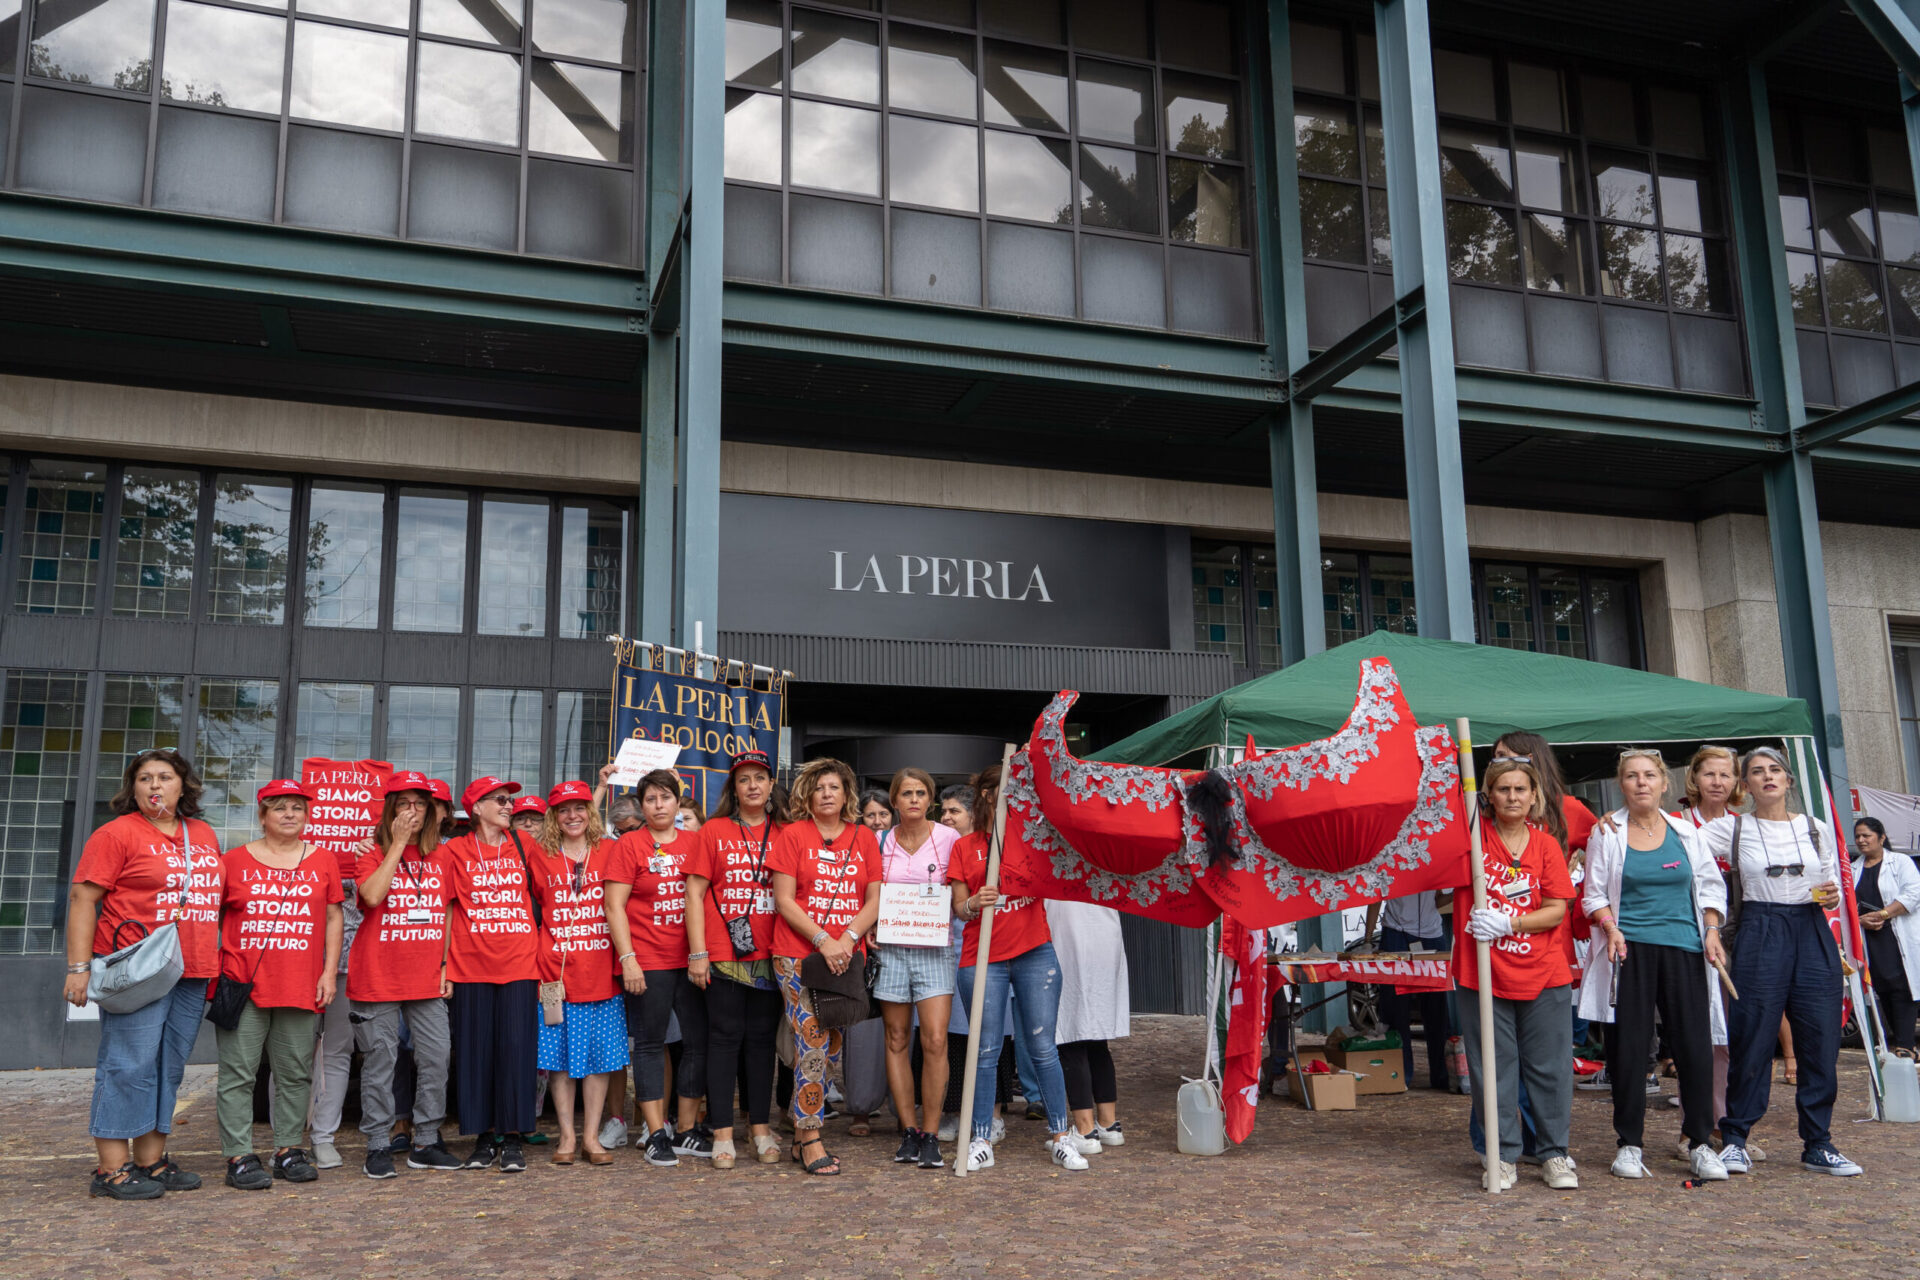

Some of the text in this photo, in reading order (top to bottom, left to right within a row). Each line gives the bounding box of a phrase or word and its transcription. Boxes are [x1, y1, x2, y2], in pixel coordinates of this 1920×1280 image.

[828, 551, 1054, 602] LA PERLA
[620, 675, 774, 732] LA PERLA
[309, 771, 382, 787] LA PERLA
[317, 788, 372, 803] SIAMO
[312, 806, 372, 820] STORIA
[303, 824, 376, 837] PRESENTE
[314, 840, 360, 852] FUTUR
[718, 840, 736, 851] LA
[727, 853, 766, 866] SIAM
[976, 850, 988, 862] L
[465, 860, 482, 872] LA
[660, 866, 680, 878] SIA
[242, 869, 319, 882] LA PERLA
[390, 876, 440, 889] SIAMO
[472, 872, 522, 886] SIAMO
[548, 871, 606, 888] LA PRL
[250, 883, 312, 896] SIAMO
[554, 886, 604, 903] SIAMO
[658, 881, 686, 896] STO
[1484, 873, 1531, 907] SIAO
[156, 891, 220, 906] PRSENT
[388, 894, 443, 908] STORIA
[470, 890, 524, 904] STORIA
[246, 900, 311, 916] STORIA
[654, 898, 686, 912] PRES
[720, 904, 778, 914] E FUT
[156, 909, 166, 922] E
[382, 912, 446, 926] PRETE
[468, 907, 528, 920] PRESENTE
[552, 904, 606, 922] STORIA
[817, 913, 856, 925] FTUR
[240, 920, 314, 935] PRESENTE
[480, 922, 532, 934] FUTURO
[654, 916, 662, 926] E
[380, 929, 442, 942] E FUTURO
[550, 922, 610, 938] PRESENTE
[240, 937, 308, 950] E FUTURO
[560, 938, 610, 952] FUTURO
[1340, 960, 1446, 978] FILCAMS
